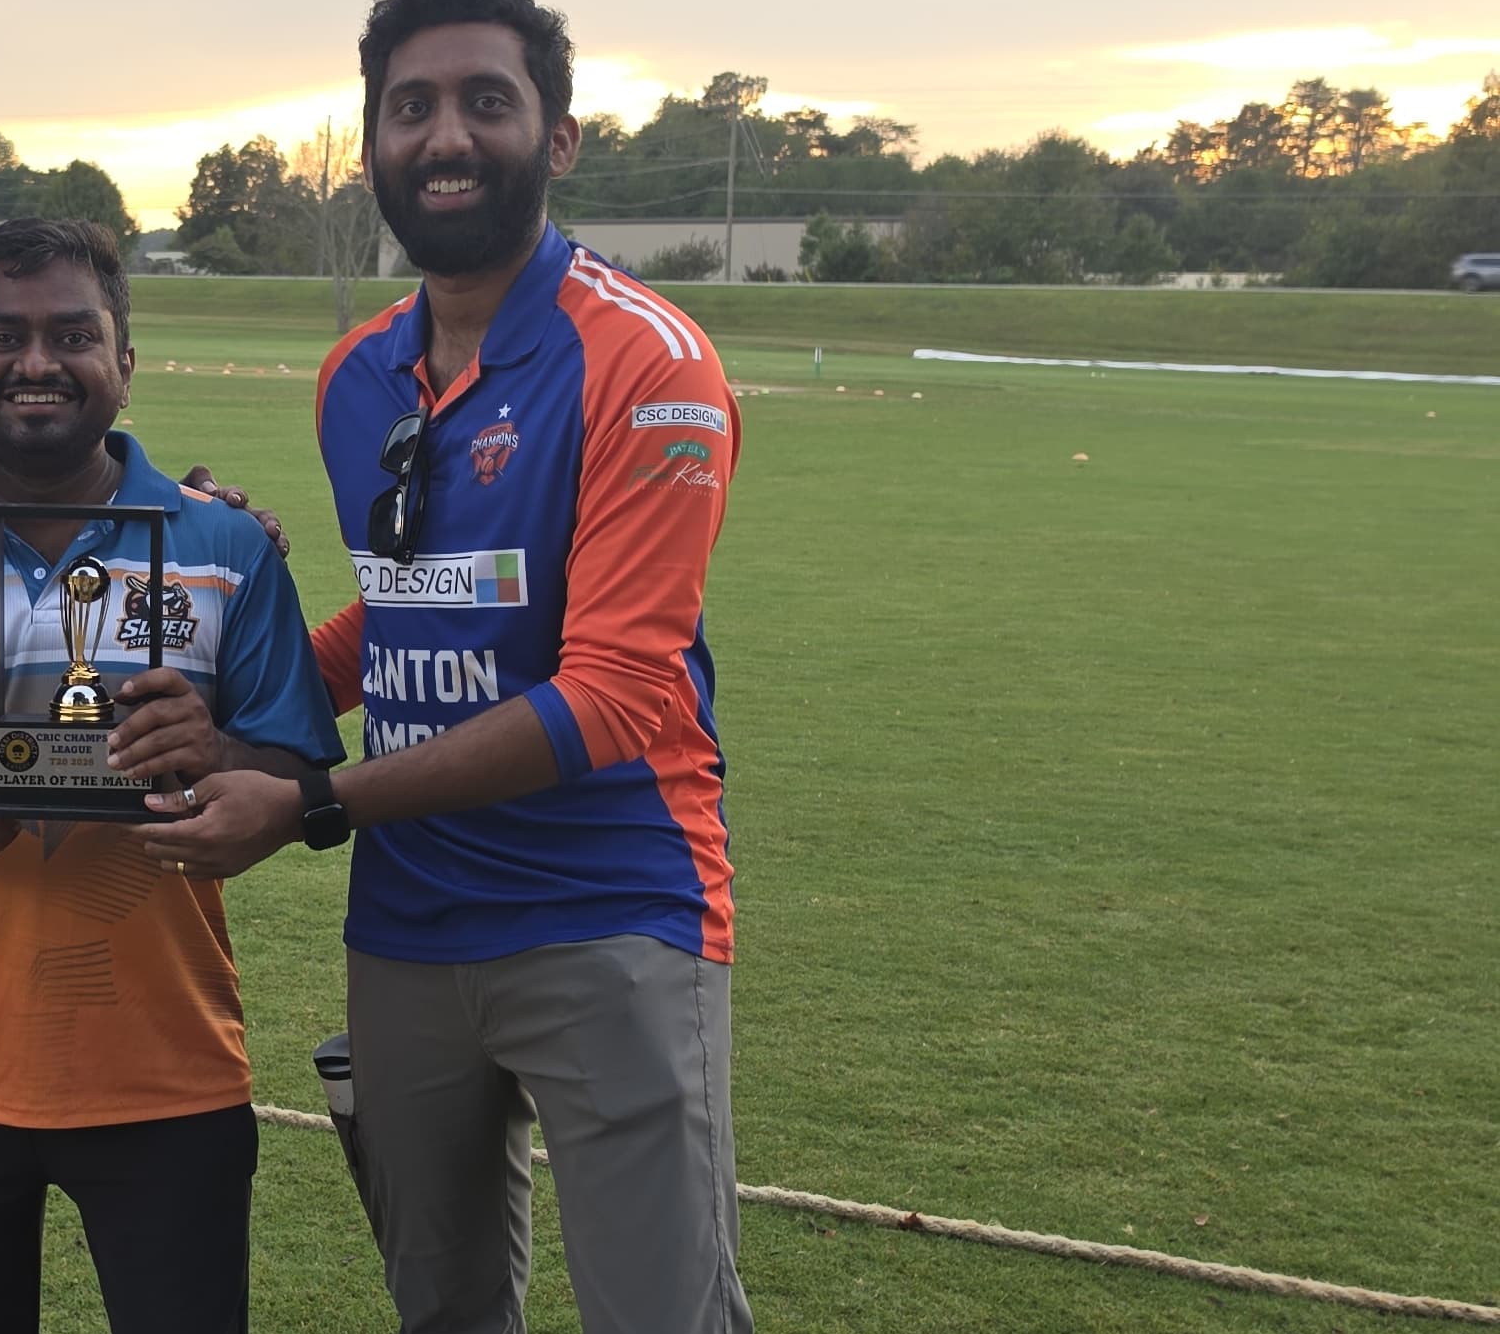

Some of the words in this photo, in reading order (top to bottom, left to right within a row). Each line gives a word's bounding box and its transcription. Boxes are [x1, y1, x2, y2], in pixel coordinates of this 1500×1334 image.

[636, 408, 667, 422] CSC
[671, 408, 717, 425] DESIGN
[379, 566, 472, 594] DESIGN
[129, 638, 184, 647] STRERS
[36, 733, 60, 742] CRIC
[63, 733, 108, 743] CHAMPS
[52, 745, 92, 754] LEAGUE
[50, 775, 67, 786] OF
[71, 776, 98, 786] THE
